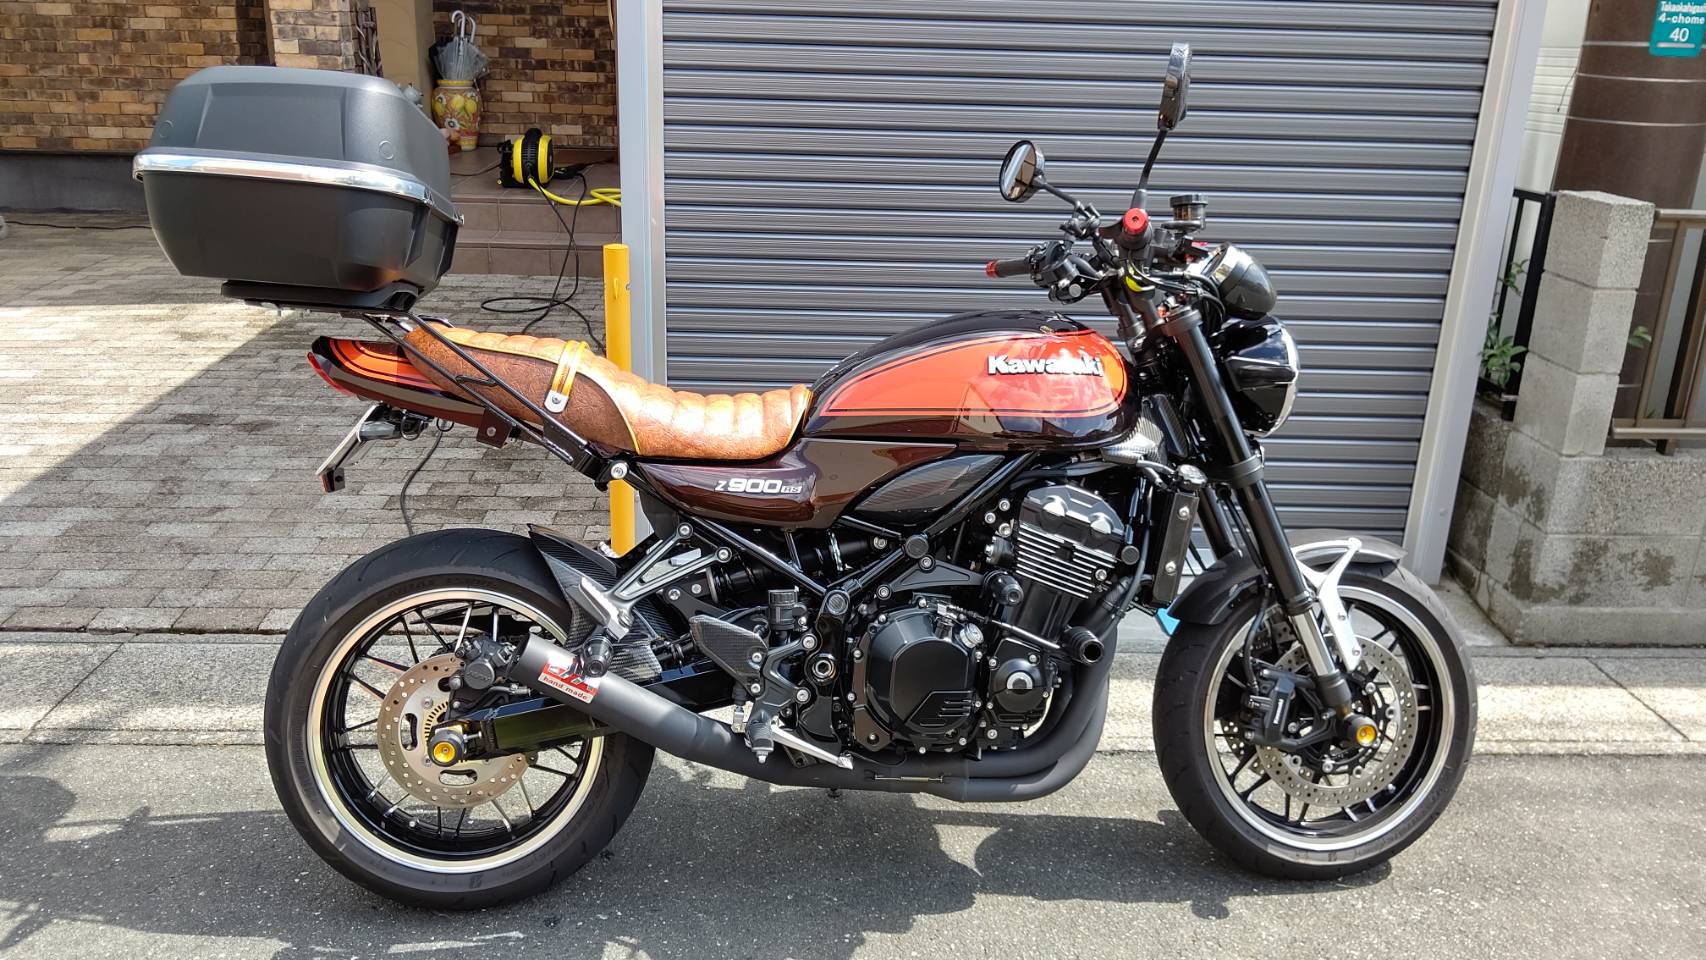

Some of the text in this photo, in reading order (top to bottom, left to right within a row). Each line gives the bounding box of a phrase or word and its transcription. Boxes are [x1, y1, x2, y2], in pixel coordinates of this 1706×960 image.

[1658, 12, 1705, 24] 4-chome
[1669, 27, 1690, 42] 40
[988, 355, 1104, 377] Kawaki
[543, 676, 589, 700] hand made
